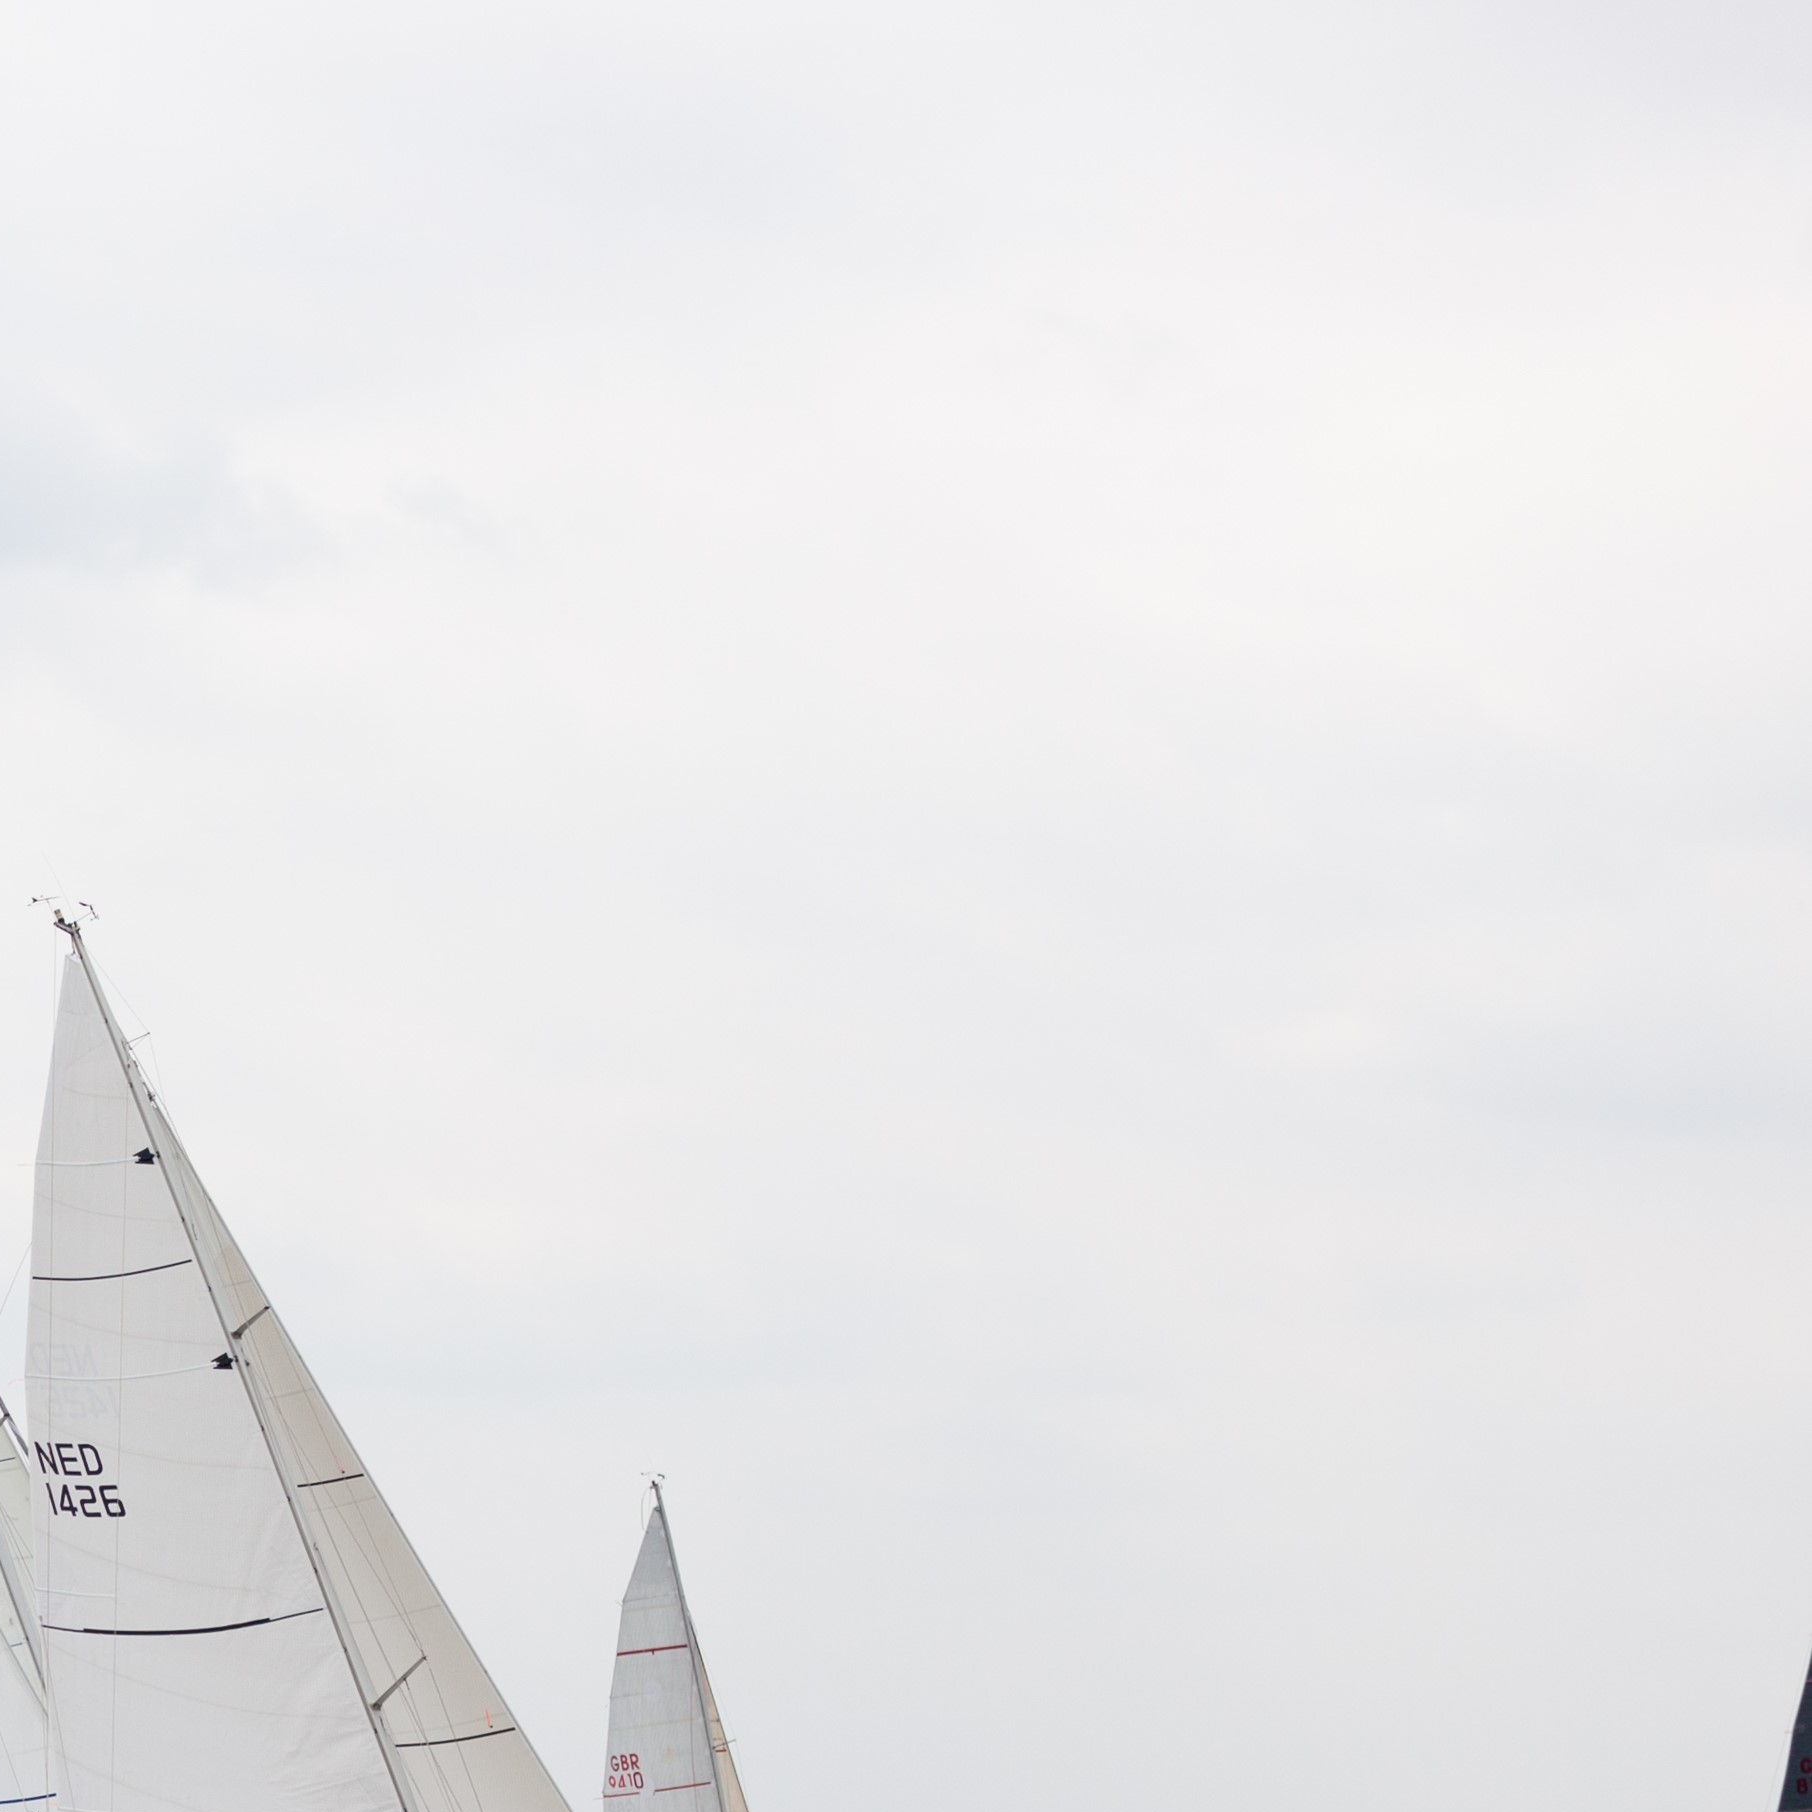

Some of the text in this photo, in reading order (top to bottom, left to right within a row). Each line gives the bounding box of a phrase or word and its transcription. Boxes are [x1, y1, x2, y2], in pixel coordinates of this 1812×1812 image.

[34, 1441, 104, 1477] NED
[45, 1482, 127, 1518] 1426
[609, 1753, 640, 1772] GBR
[608, 1771, 644, 1790] 9410
